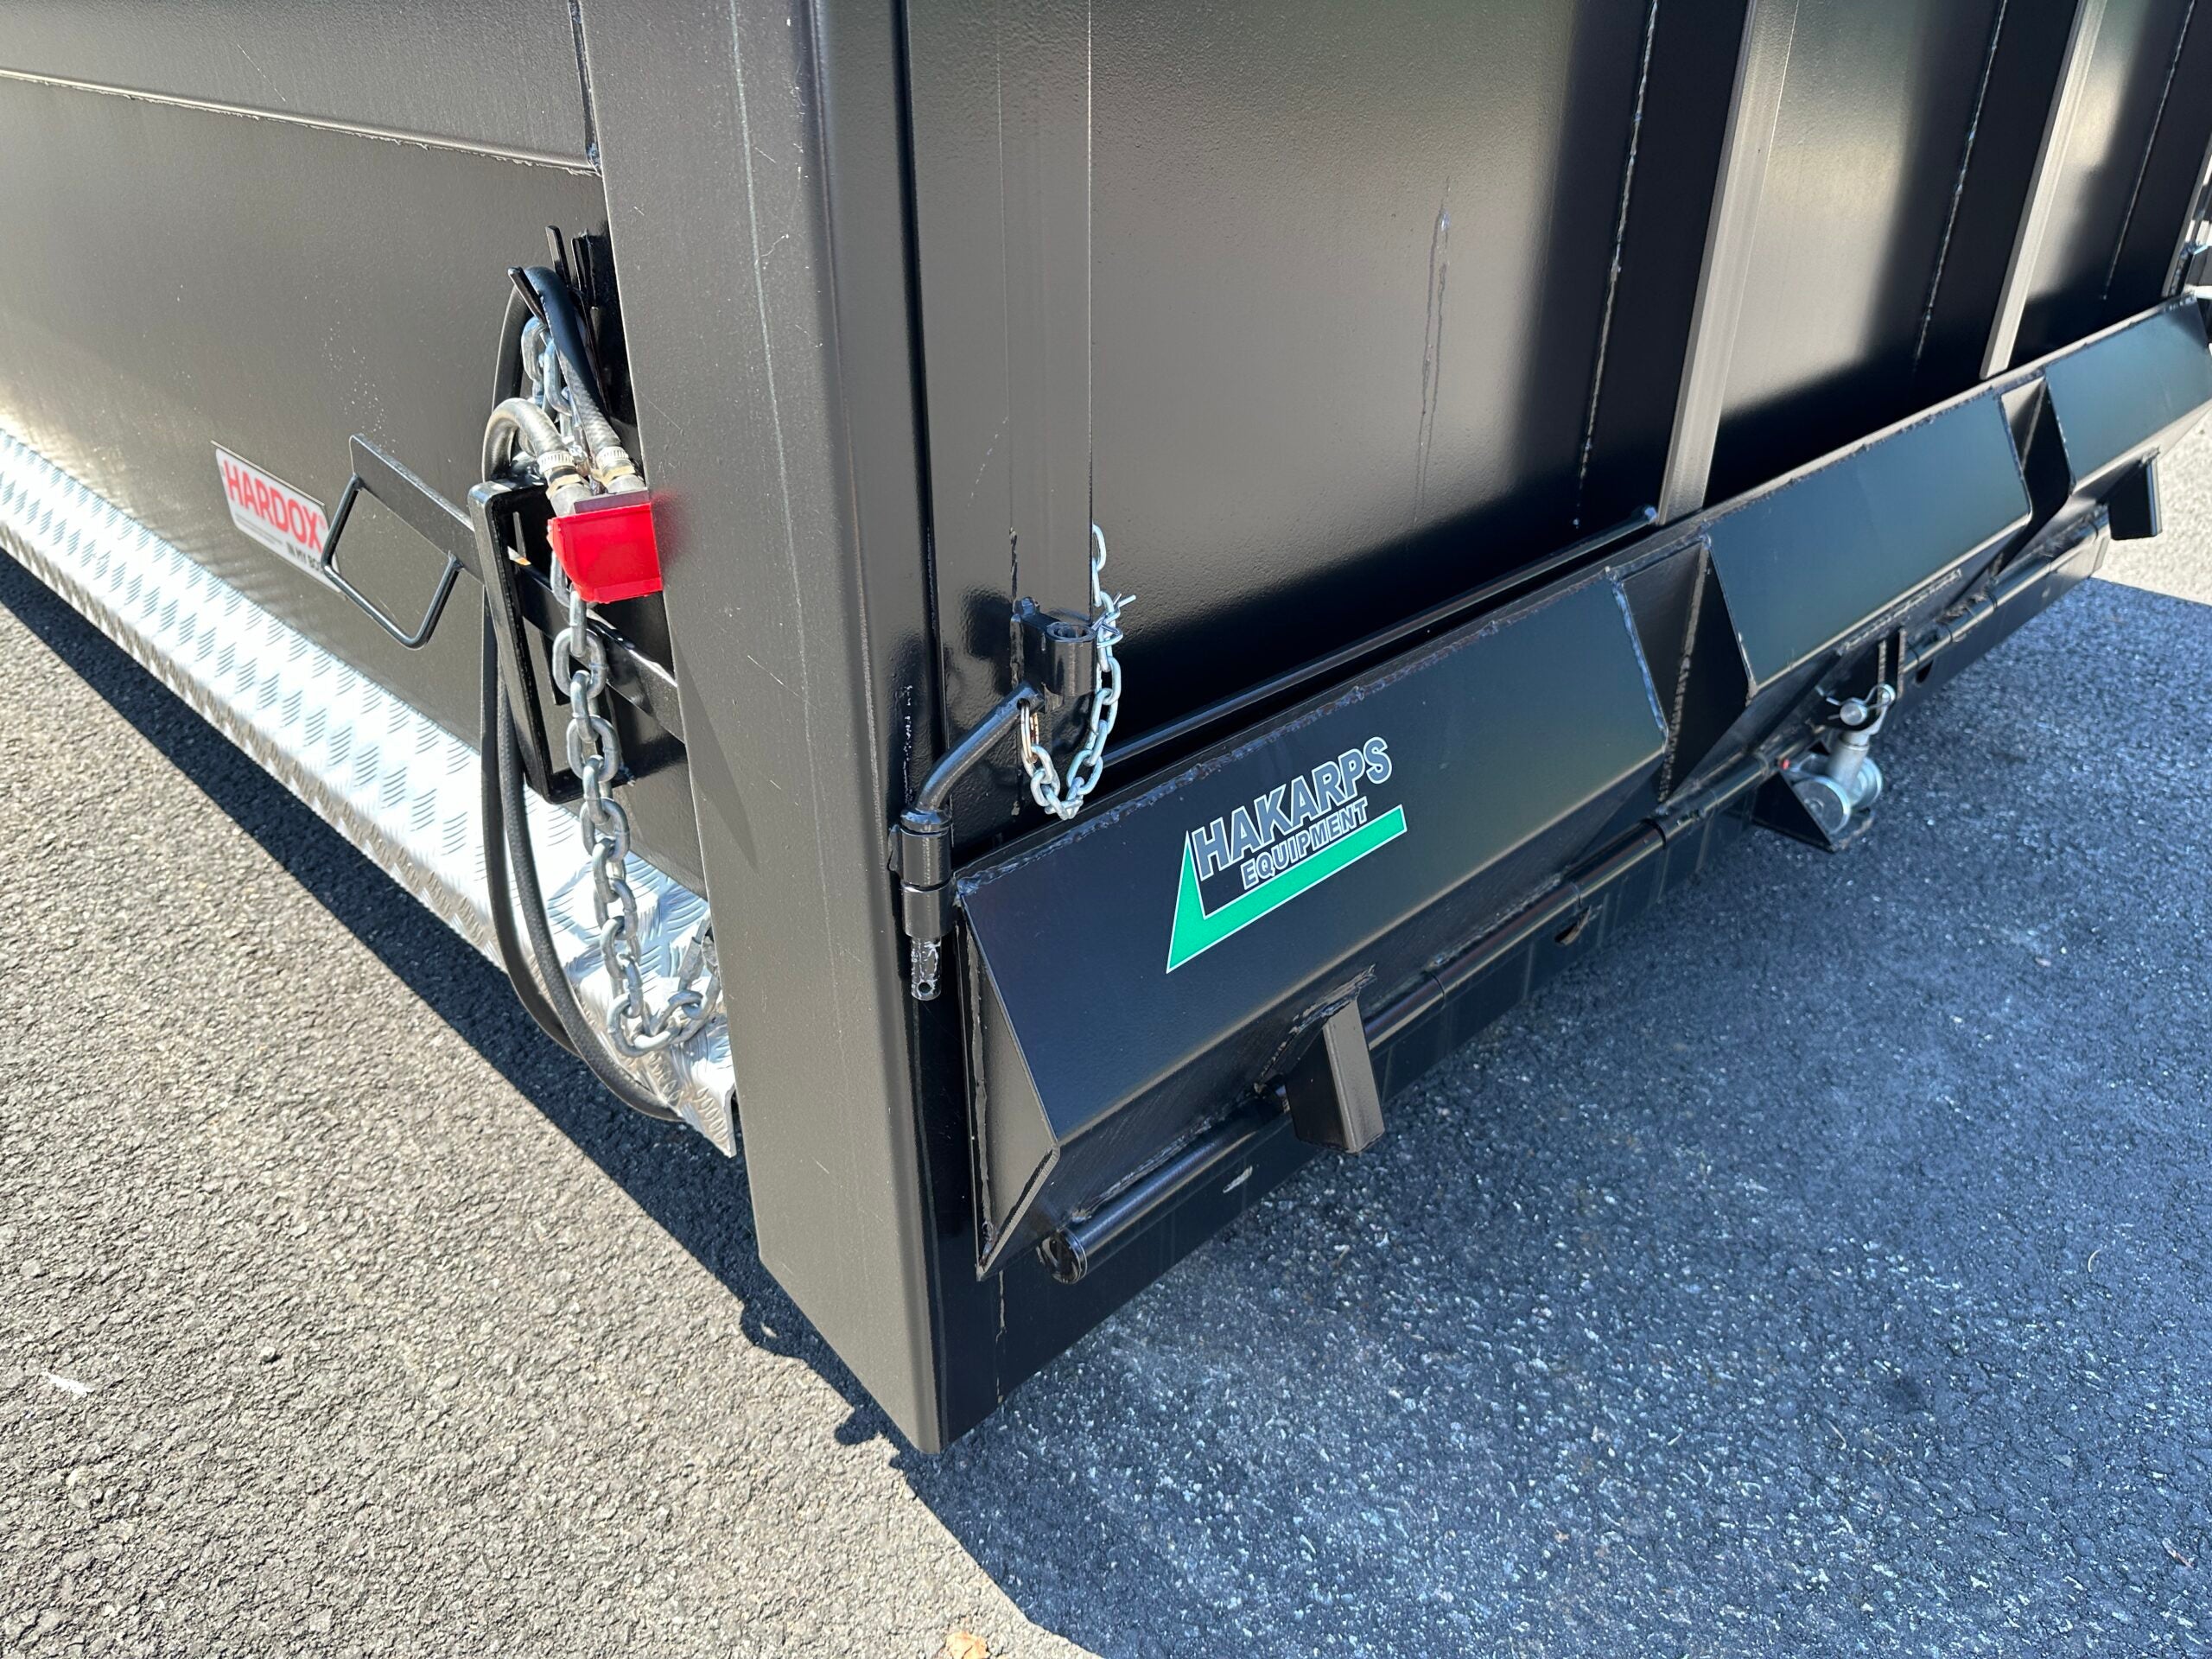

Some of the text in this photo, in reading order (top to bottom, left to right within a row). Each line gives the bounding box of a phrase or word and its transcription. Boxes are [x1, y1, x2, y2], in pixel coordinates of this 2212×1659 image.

[224, 460, 323, 554] HARDOX
[1192, 736, 1393, 881] HAKARPS
[1240, 796, 1369, 890] EQUIPMENT
